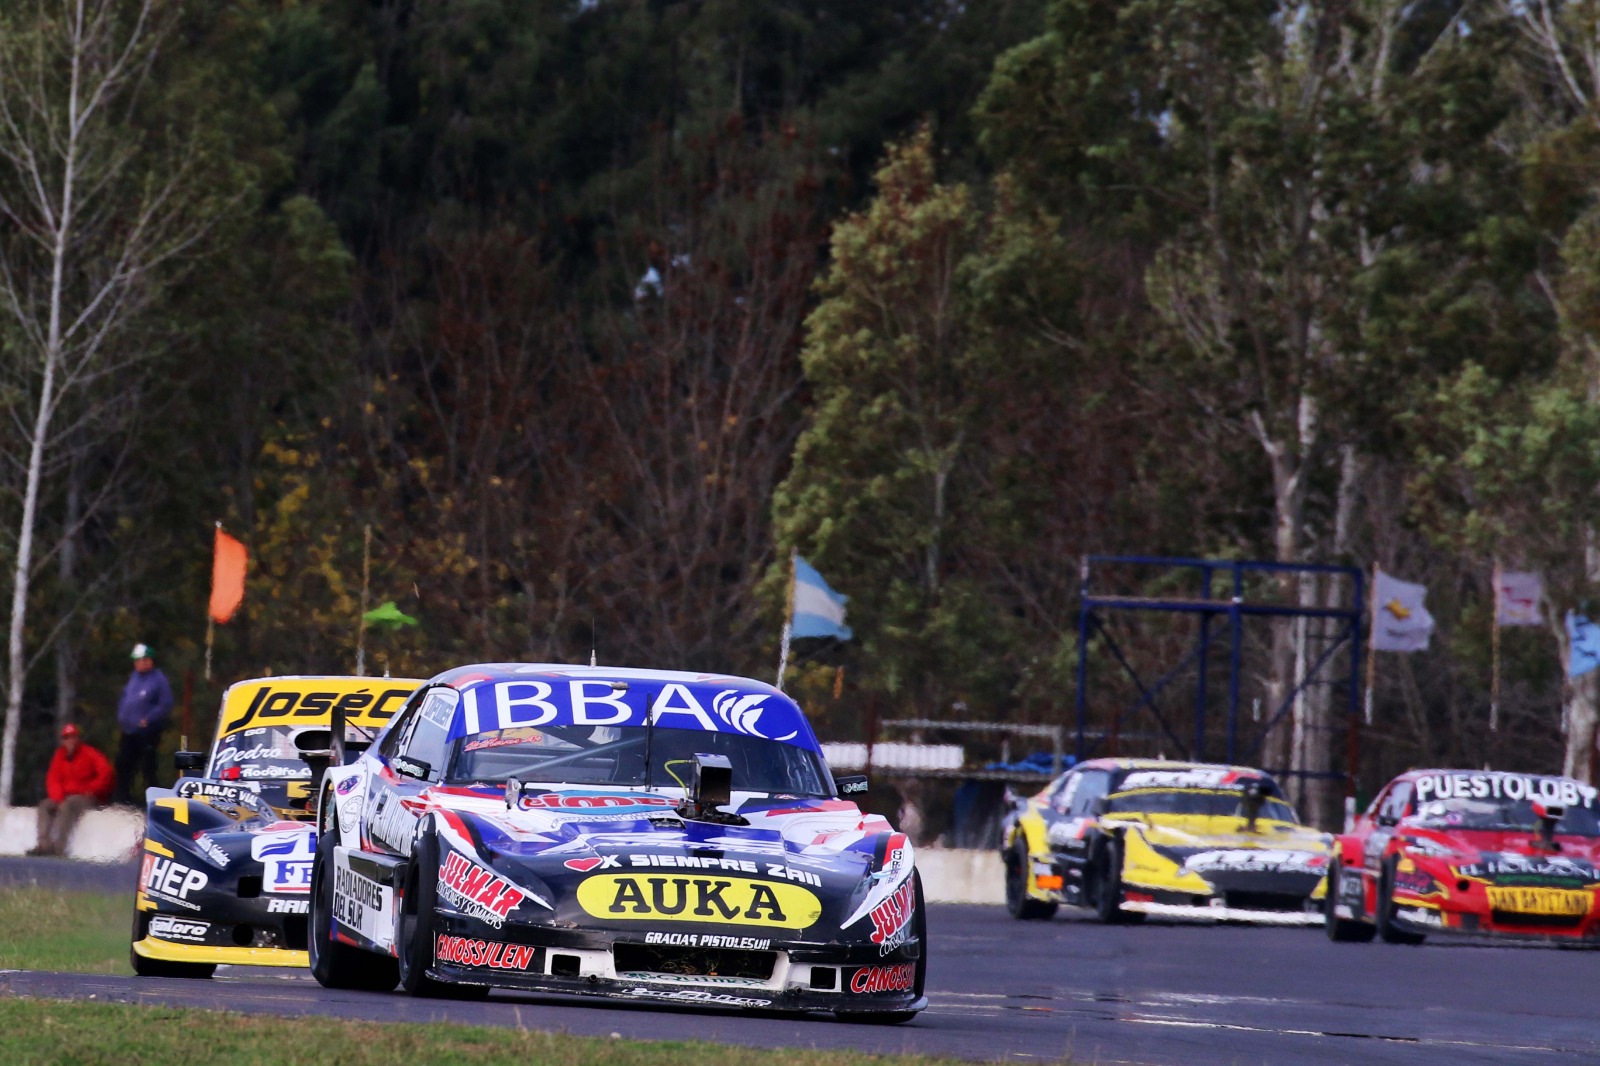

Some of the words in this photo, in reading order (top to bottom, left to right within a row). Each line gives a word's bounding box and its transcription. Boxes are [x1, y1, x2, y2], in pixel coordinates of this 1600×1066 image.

[463, 680, 719, 735] IBBA
[215, 744, 282, 771] Pedro
[204, 784, 236, 798] MJC
[629, 854, 758, 873] SIEMPRE
[336, 865, 383, 911] RADIADORES
[439, 851, 526, 920] JULMAR
[608, 878, 787, 922] AUKA
[334, 892, 346, 921] DEL
[347, 899, 363, 930] SUR
[645, 932, 698, 947] GRACIAS
